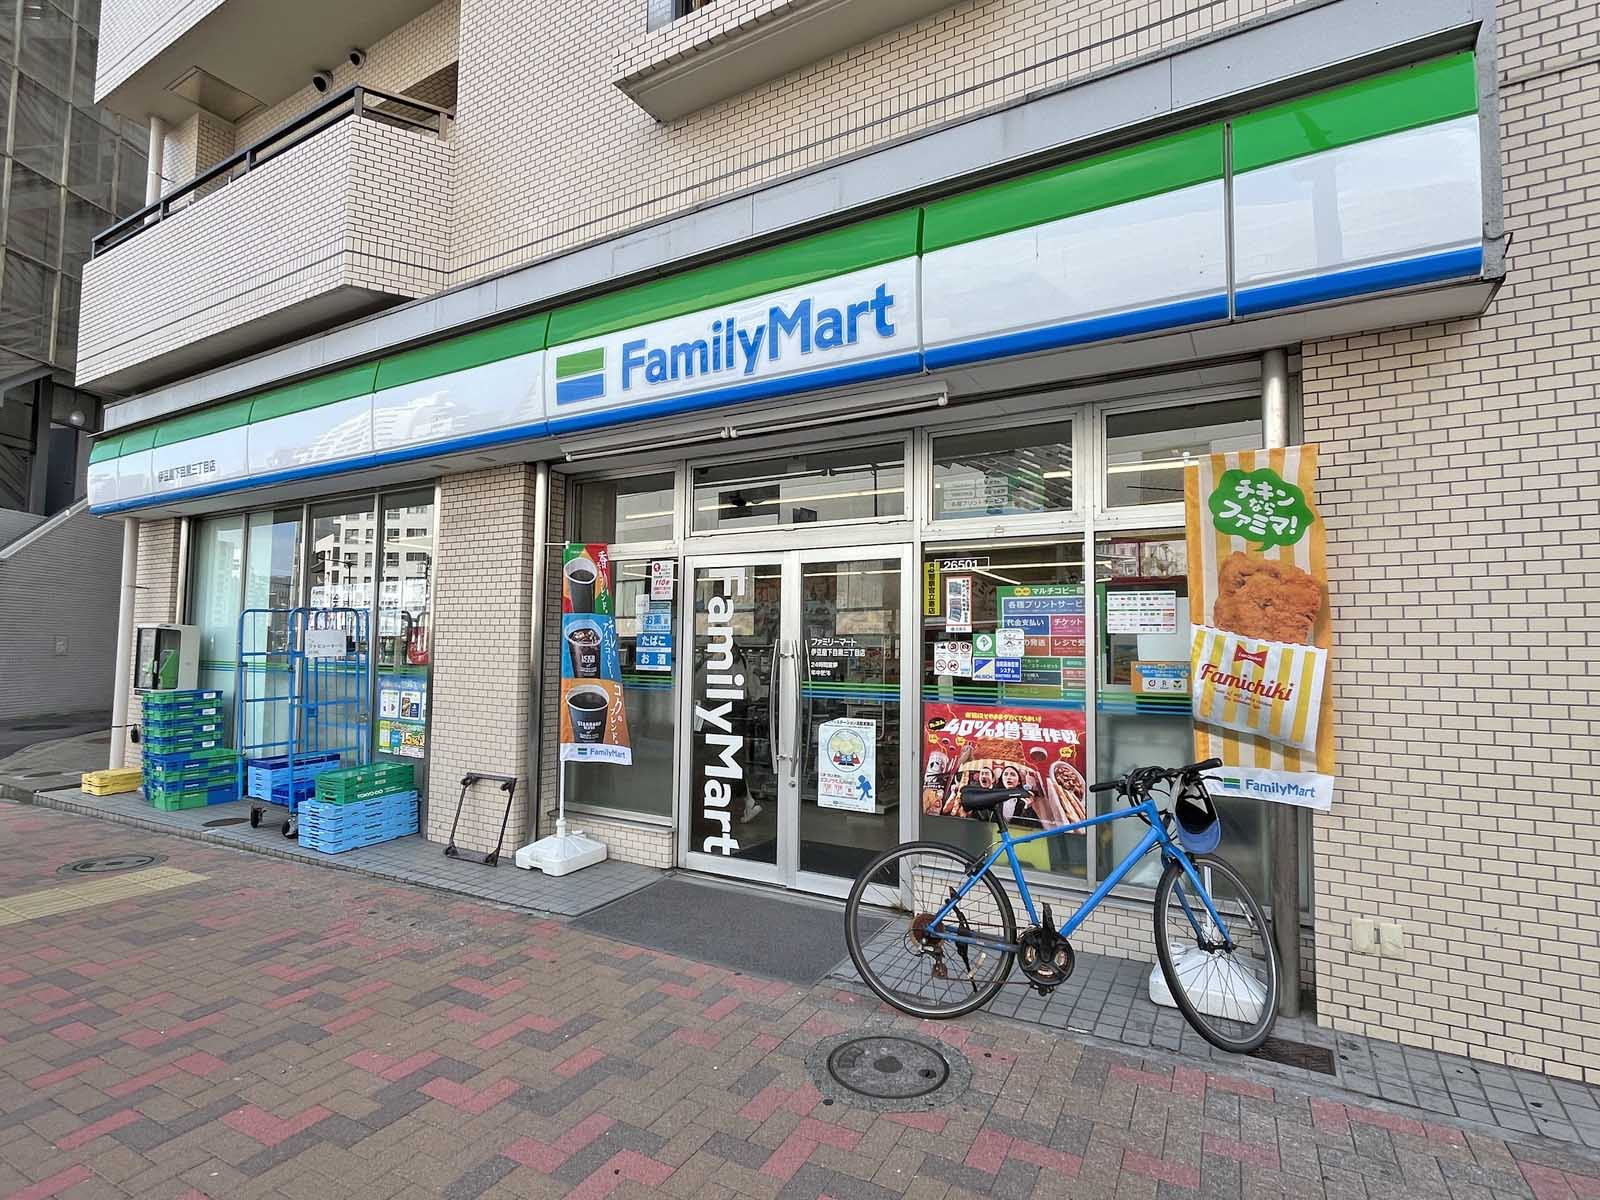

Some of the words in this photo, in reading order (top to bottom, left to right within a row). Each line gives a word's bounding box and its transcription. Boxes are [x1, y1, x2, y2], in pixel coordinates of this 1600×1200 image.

[622, 282, 896, 391] FamilyMart
[1235, 479, 1295, 506] チキン
[1249, 498, 1276, 515] なら
[943, 559, 978, 569] 26501
[1008, 600, 1083, 609] 各種プリントサービ
[1007, 618, 1045, 627] 代金支払い
[641, 635, 666, 646] たばこ
[810, 637, 857, 647] ファミリーマート
[1200, 663, 1290, 701] Famichiki
[695, 568, 746, 856] FamilyMart
[939, 717, 1080, 745] 40%増量作戦
[590, 747, 626, 759] FamilyMart
[1246, 779, 1316, 798] FamilyMart
